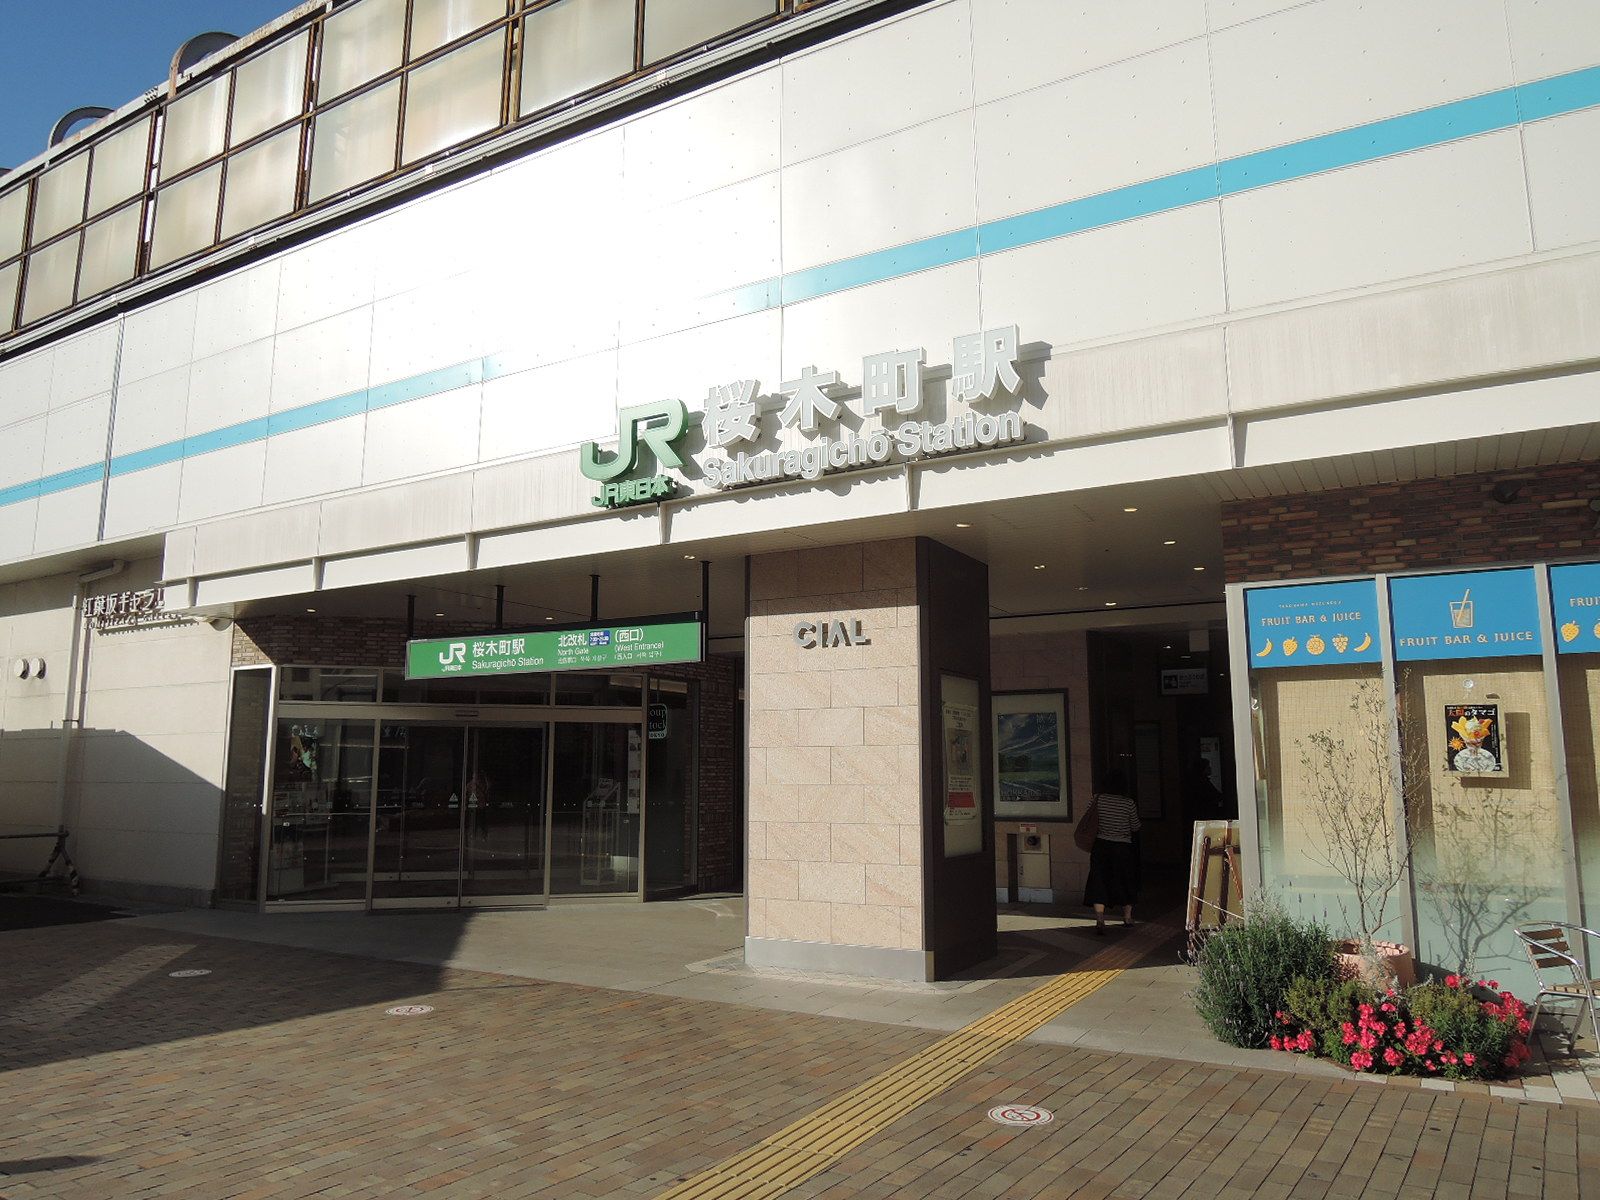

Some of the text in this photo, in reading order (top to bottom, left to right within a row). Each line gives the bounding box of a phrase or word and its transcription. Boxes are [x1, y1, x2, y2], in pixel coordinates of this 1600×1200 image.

[702, 324, 1024, 447] 桜木町駅
[579, 398, 689, 482] JR
[702, 409, 1027, 490] Sakuragichō Station
[590, 474, 678, 509] JR東日本
[1569, 595, 1600, 608] FRUI
[1261, 611, 1362, 627] FRUIT BAR & JUICE
[558, 633, 587, 647] 北改札
[793, 617, 867, 648] CIAL
[1399, 631, 1533, 647] FRUIT BAR & JUICE
[439, 642, 467, 665] JR
[472, 638, 525, 658] 桜木町駅
[557, 648, 574, 656] North
[575, 647, 589, 655] Gate
[518, 656, 544, 667] Station
[649, 708, 665, 718] oup
[649, 720, 666, 730] tock
